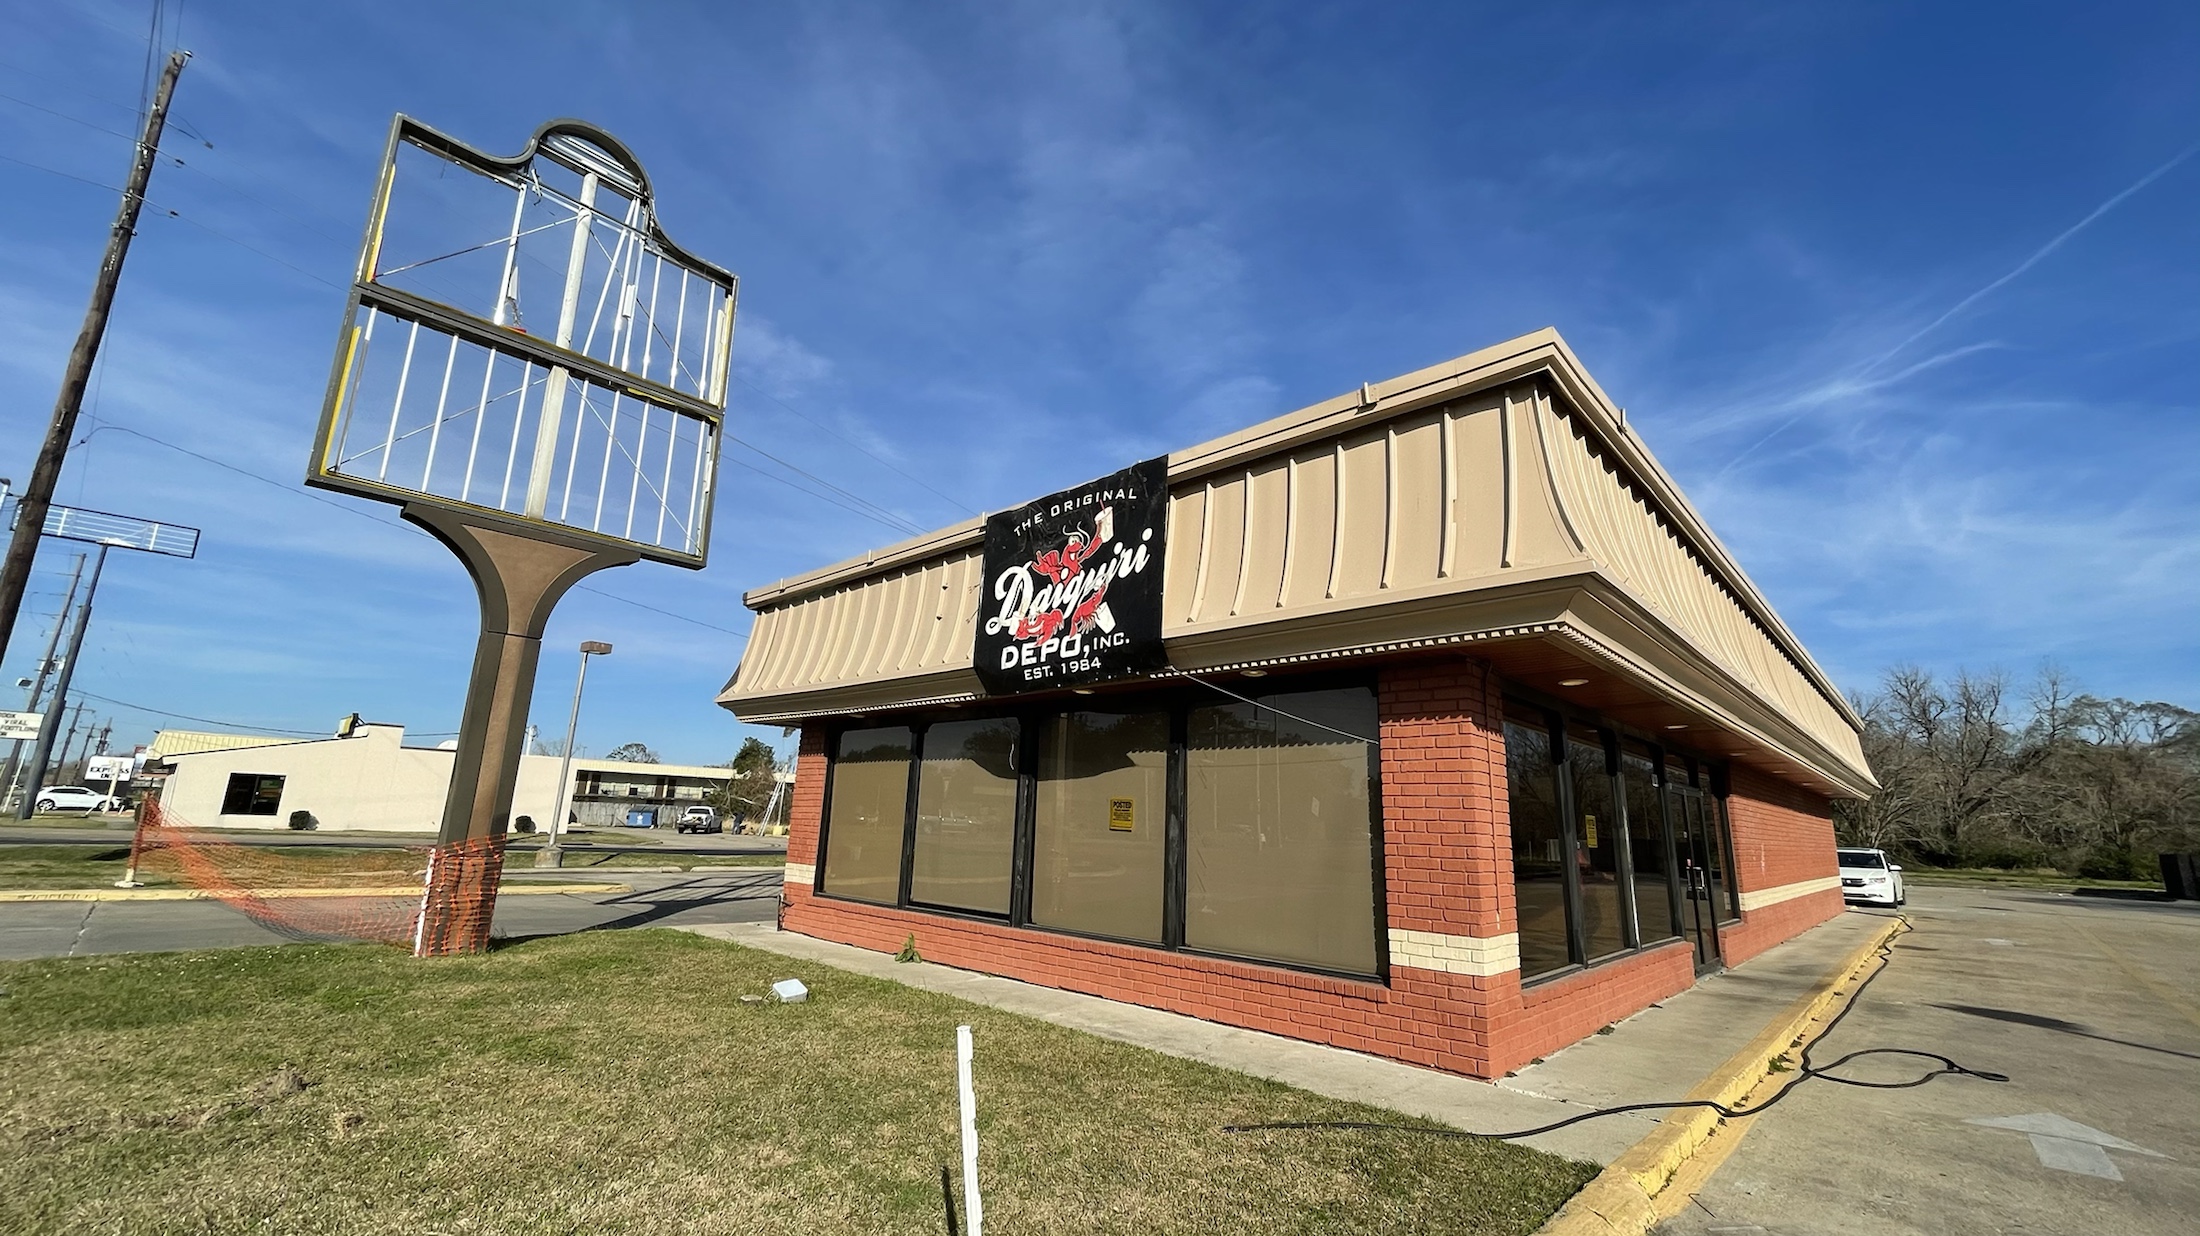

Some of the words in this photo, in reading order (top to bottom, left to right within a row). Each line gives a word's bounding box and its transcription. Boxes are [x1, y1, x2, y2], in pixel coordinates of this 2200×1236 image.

[1013, 512, 1043, 537] THE
[1050, 488, 1137, 517] ORIGINAL
[1093, 632, 1130, 651] INC.
[1023, 665, 1054, 681] EST.
[1060, 656, 1101, 675] 1984
